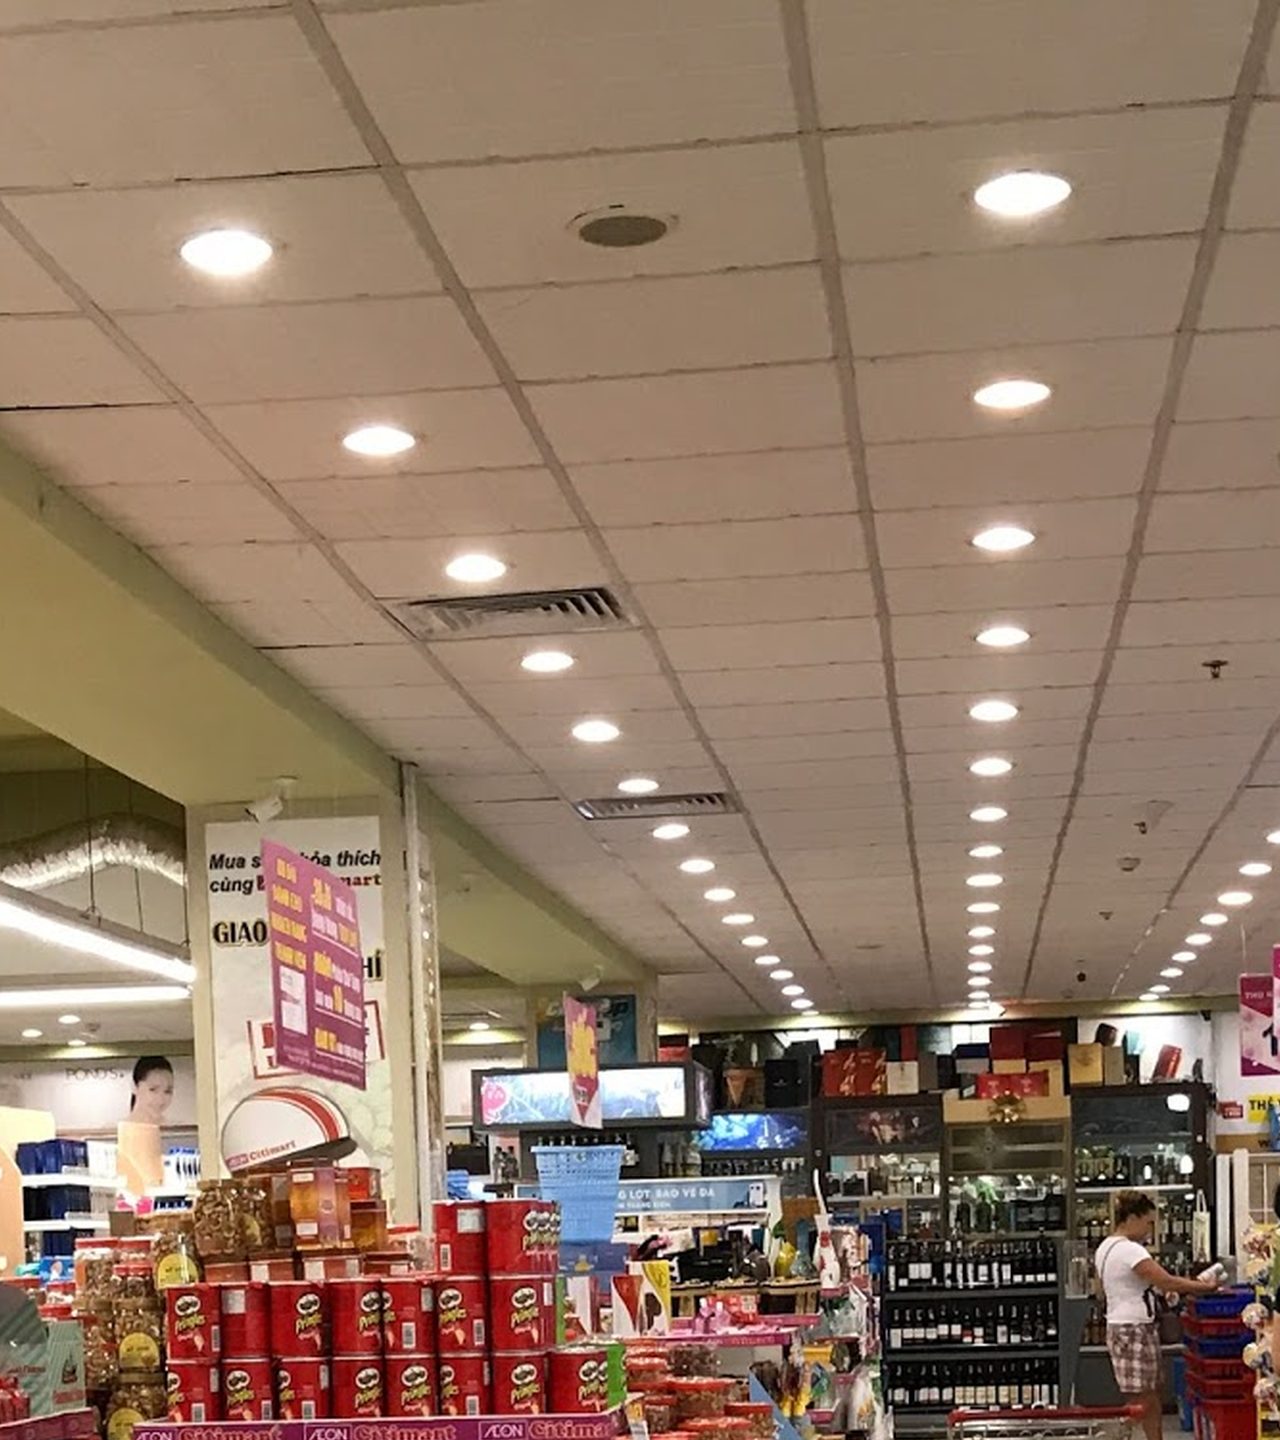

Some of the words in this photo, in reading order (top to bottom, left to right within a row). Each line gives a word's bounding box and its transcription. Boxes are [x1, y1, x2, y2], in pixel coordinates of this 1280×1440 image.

[210, 853, 246, 870] Mua
[337, 849, 382, 868] thích
[210, 874, 254, 895] cùng
[213, 921, 269, 945] GIAO
[1261, 1023, 1279, 1057] 1
